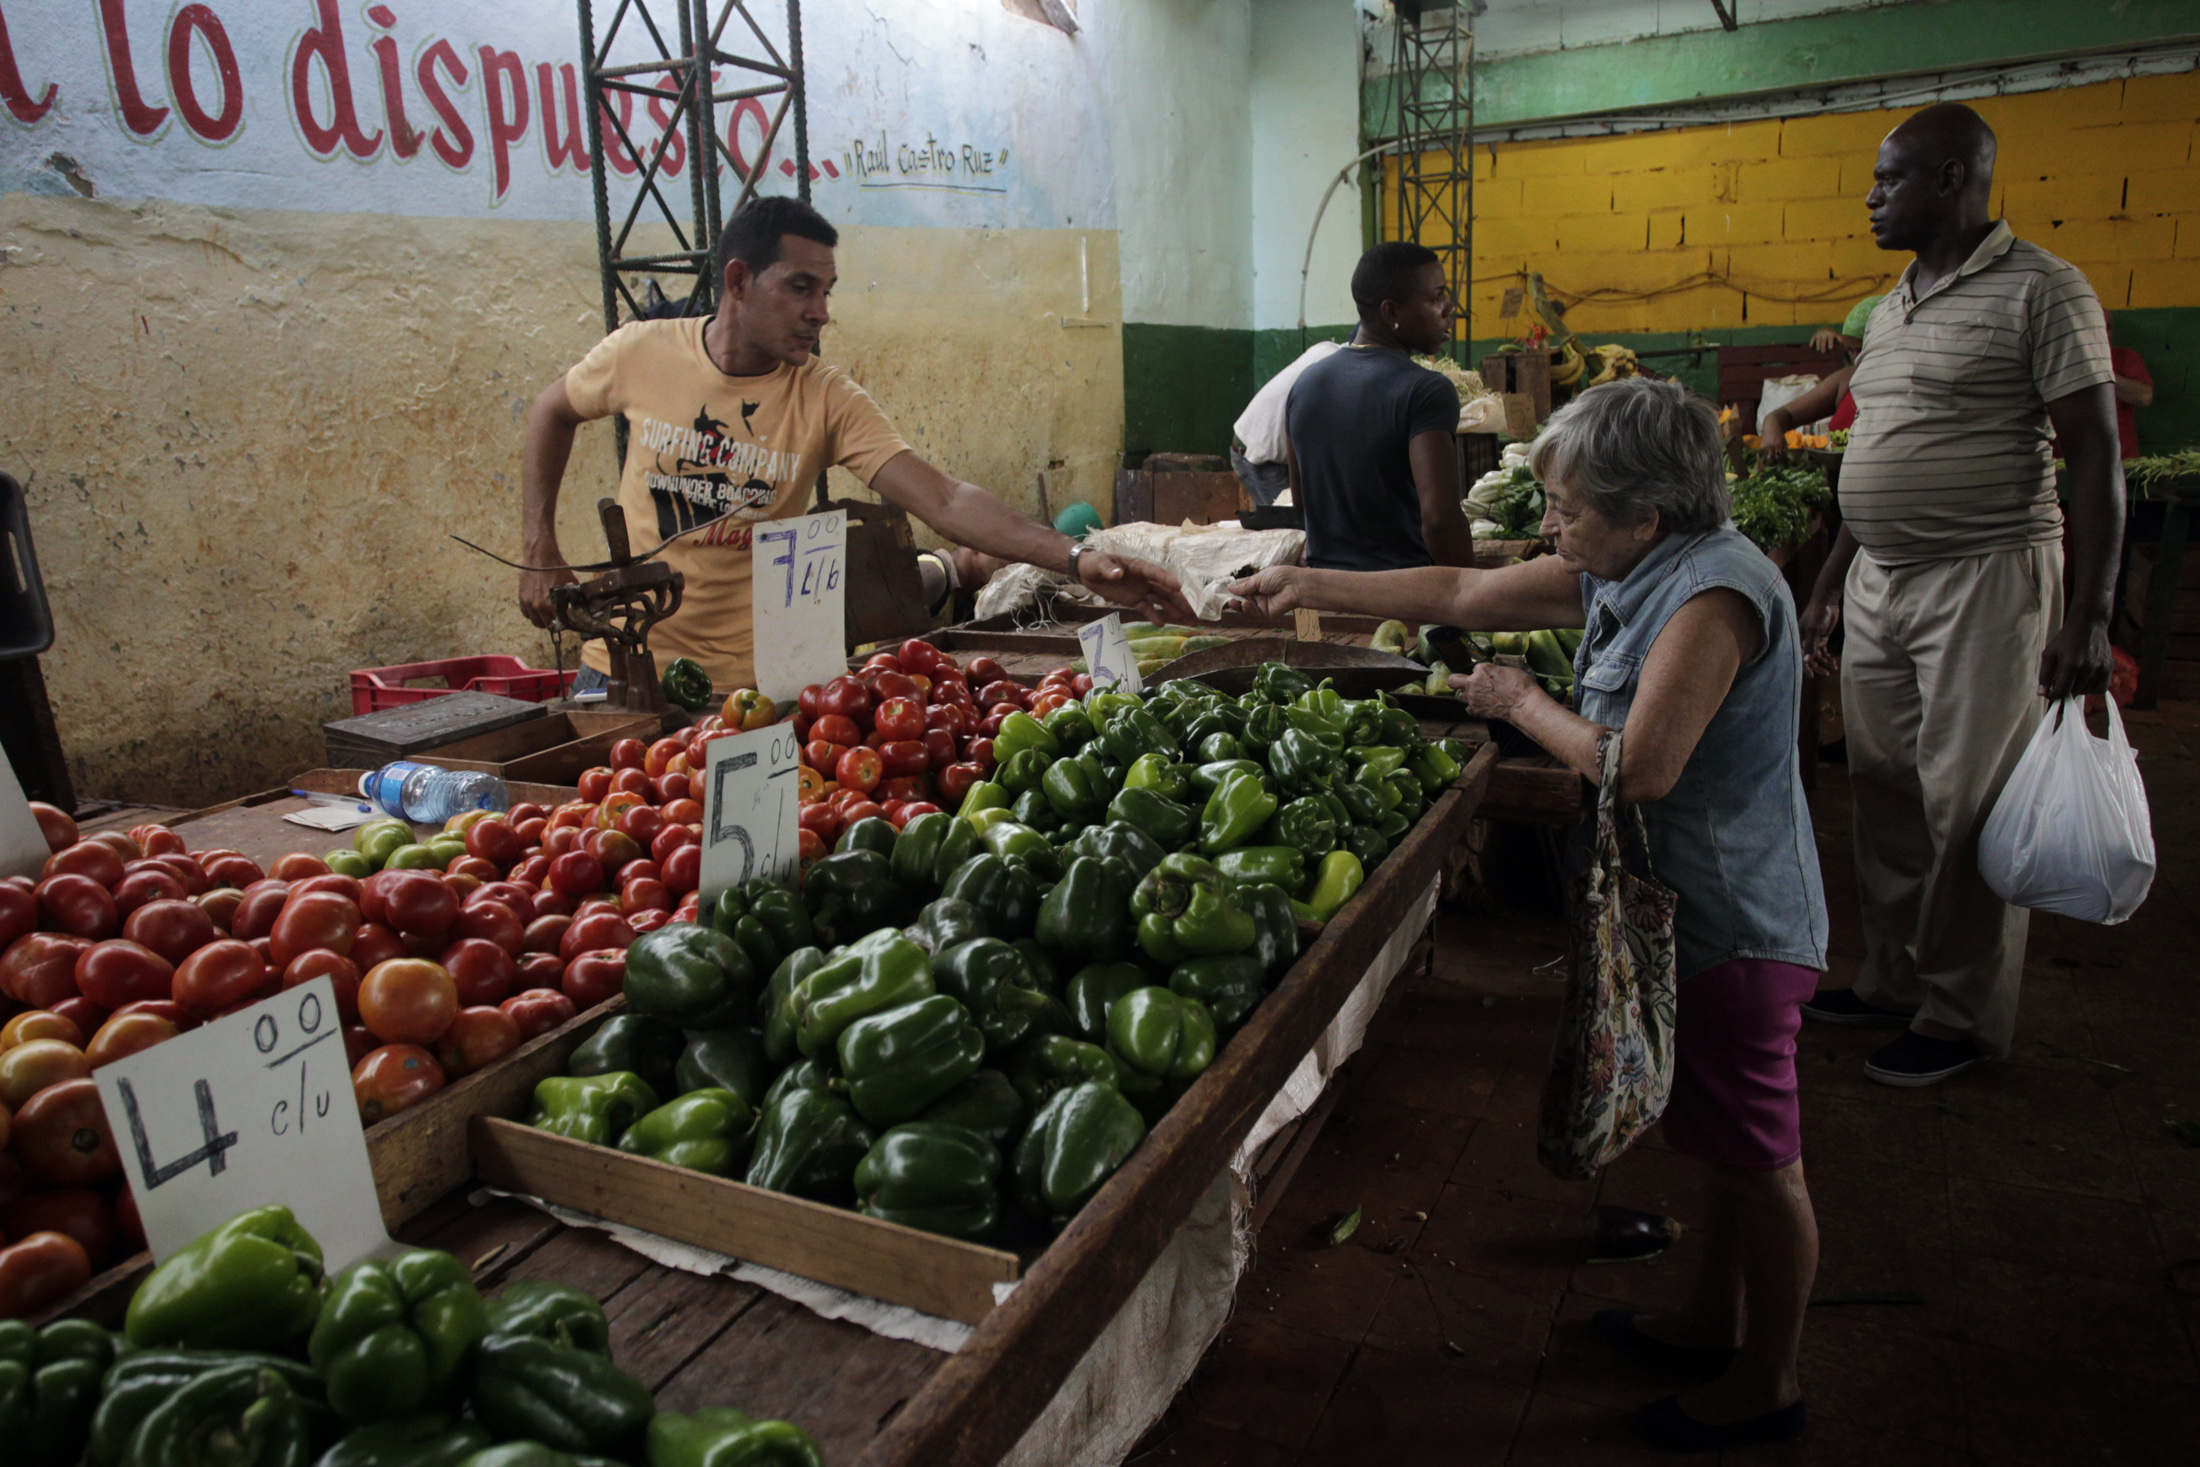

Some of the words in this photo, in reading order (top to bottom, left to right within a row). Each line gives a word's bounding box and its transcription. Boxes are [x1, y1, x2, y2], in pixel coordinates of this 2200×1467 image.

[101, 0, 243, 140] lo
[293, 0, 839, 200] dispueso...
[898, 131, 955, 173] Castro
[640, 418, 714, 464] SURFING
[716, 435, 801, 483] COMPANY
[756, 528, 797, 608] 7
[807, 516, 839, 540] 00
[710, 752, 755, 888] 5
[770, 732, 795, 765] 00
[760, 788, 792, 882] c/u
[117, 1076, 238, 1191] 4
[254, 992, 321, 1053] 00
[271, 1060, 330, 1135] c/u
